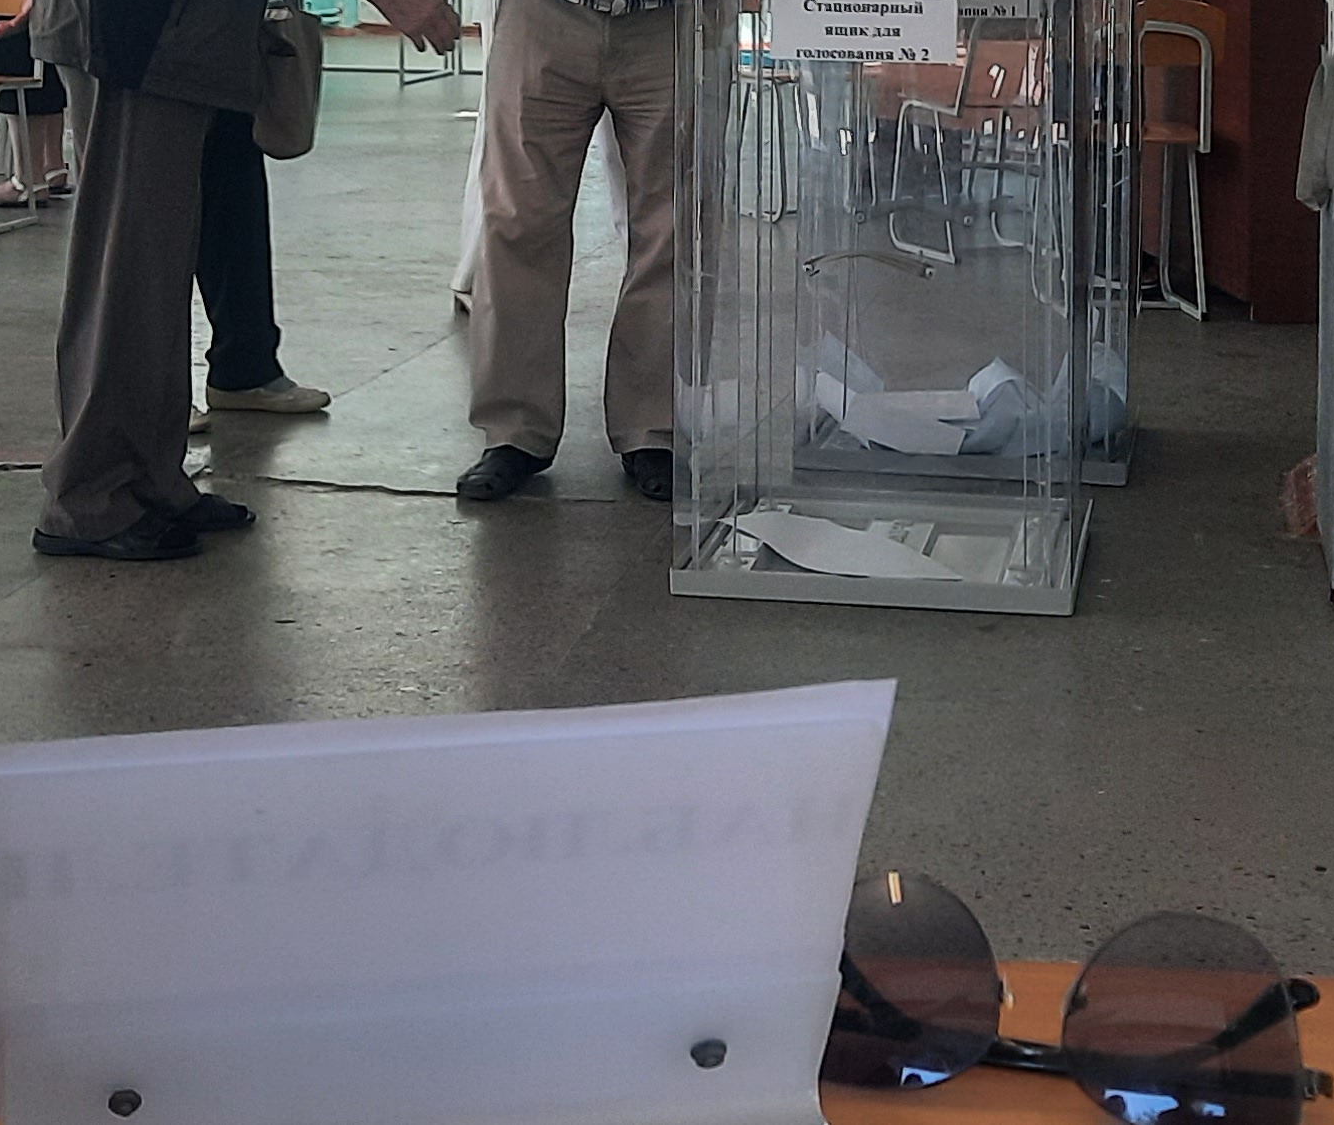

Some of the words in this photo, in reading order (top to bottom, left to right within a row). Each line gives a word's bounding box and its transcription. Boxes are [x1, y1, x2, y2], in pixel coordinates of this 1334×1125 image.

[803, 0, 924, 17] Стационарный
[825, 26, 869, 39] ящик
[872, 27, 902, 39] для
[796, 48, 895, 61] голосования
[898, 48, 917, 61] №
[921, 48, 931, 61] 2
